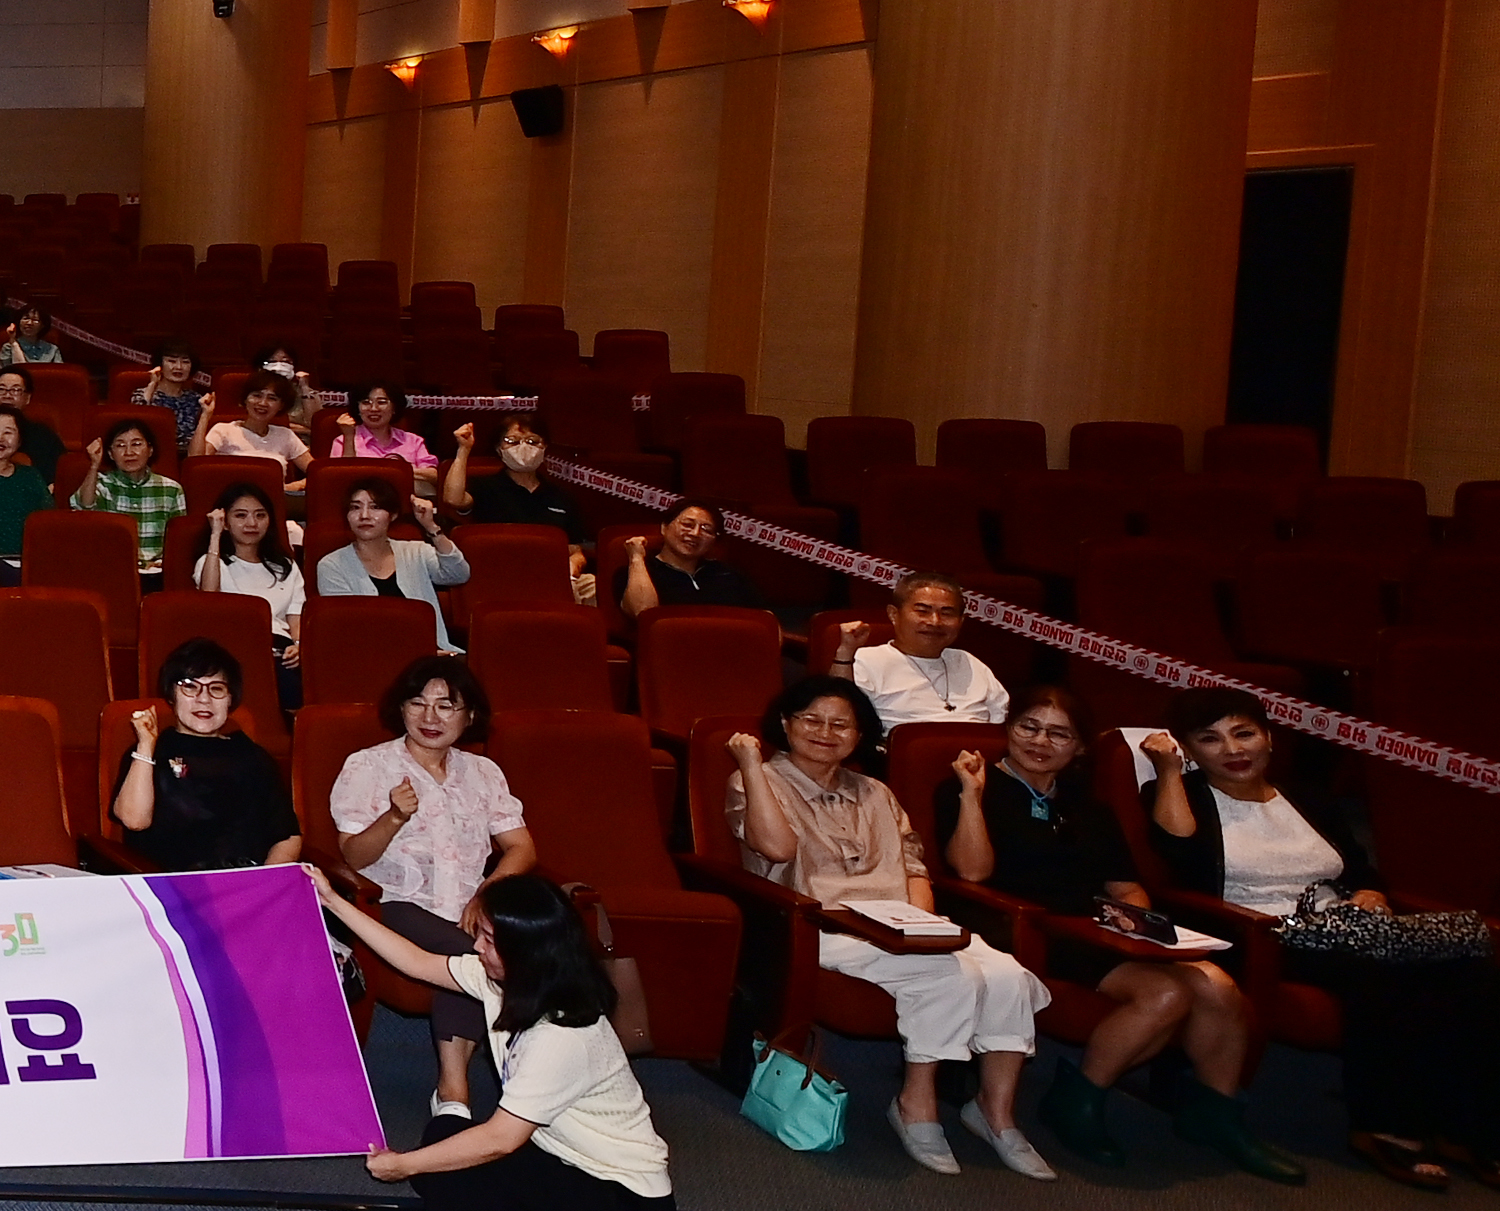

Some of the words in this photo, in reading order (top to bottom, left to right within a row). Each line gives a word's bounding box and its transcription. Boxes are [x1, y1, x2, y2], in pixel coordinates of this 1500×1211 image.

[1002, 609, 1025, 628] 위험
[1029, 620, 1074, 645] DANGER
[1077, 635, 1127, 664] 안전제일
[1154, 661, 1181, 682] 위험
[1336, 721, 1368, 745] 위험
[1374, 733, 1440, 768] DANGER
